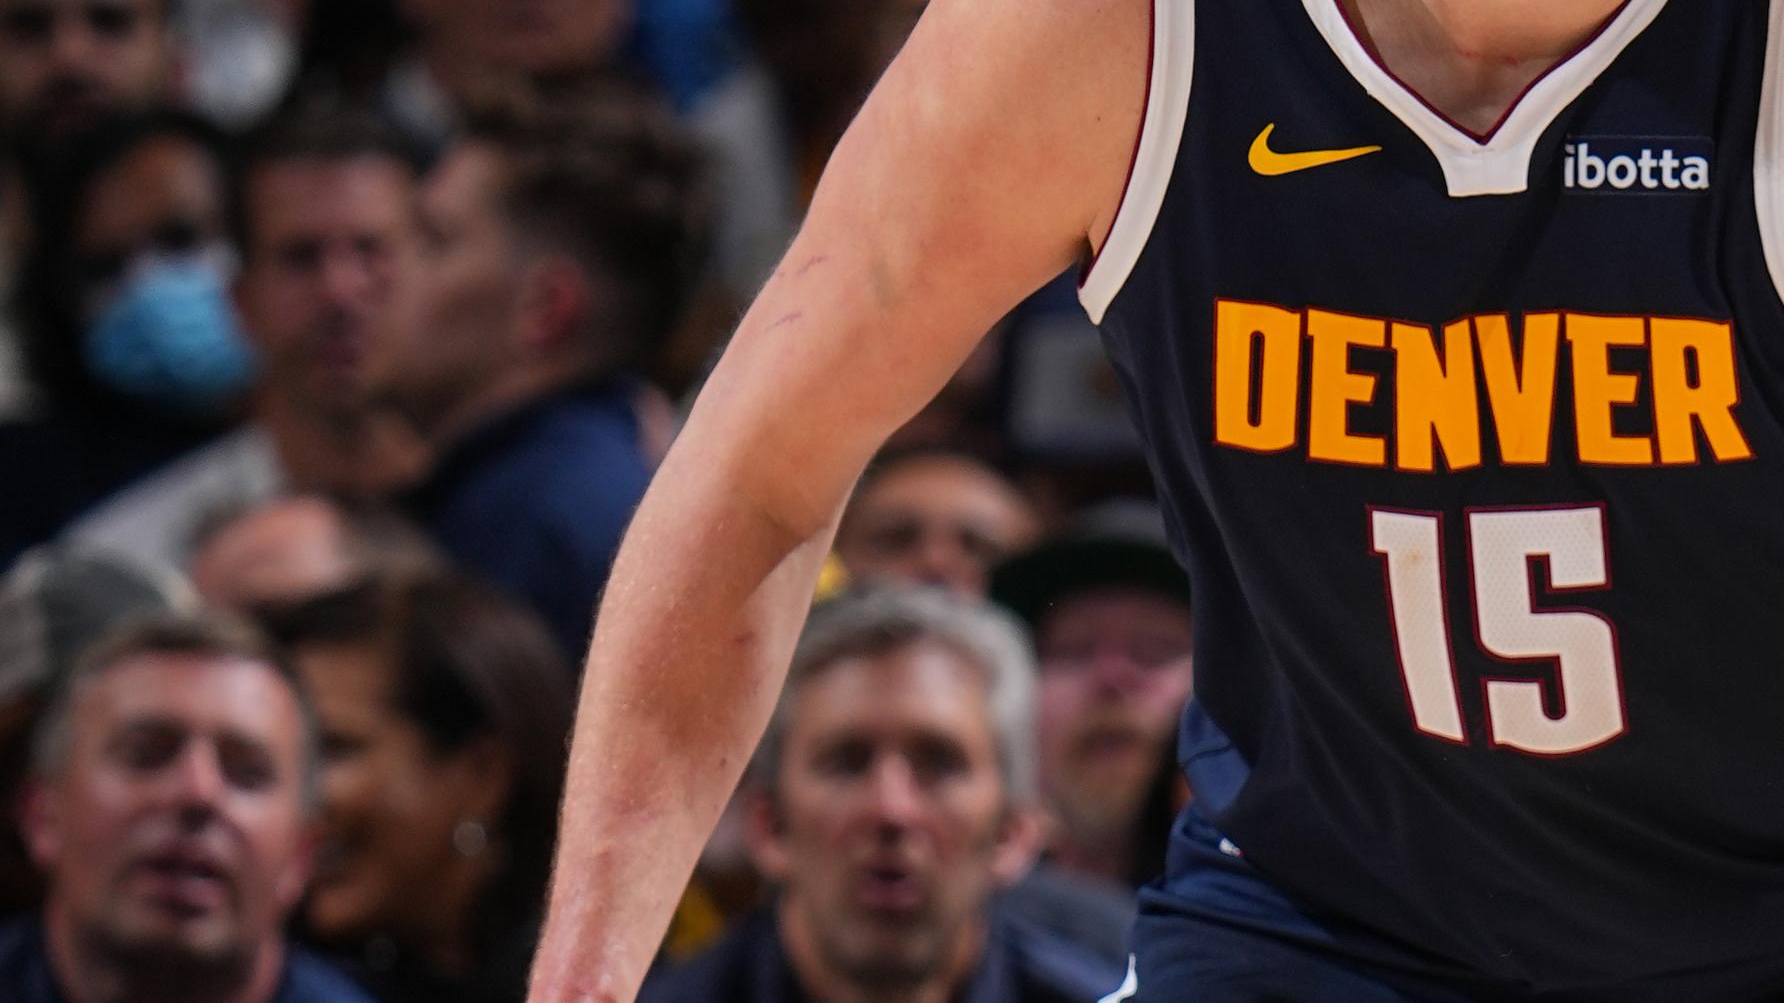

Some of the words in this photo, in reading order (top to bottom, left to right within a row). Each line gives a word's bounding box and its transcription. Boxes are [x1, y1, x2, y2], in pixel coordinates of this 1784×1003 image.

[1564, 143, 1709, 189] ibotta
[1213, 298, 1755, 473] DENVER
[1367, 501, 1627, 757] 15
